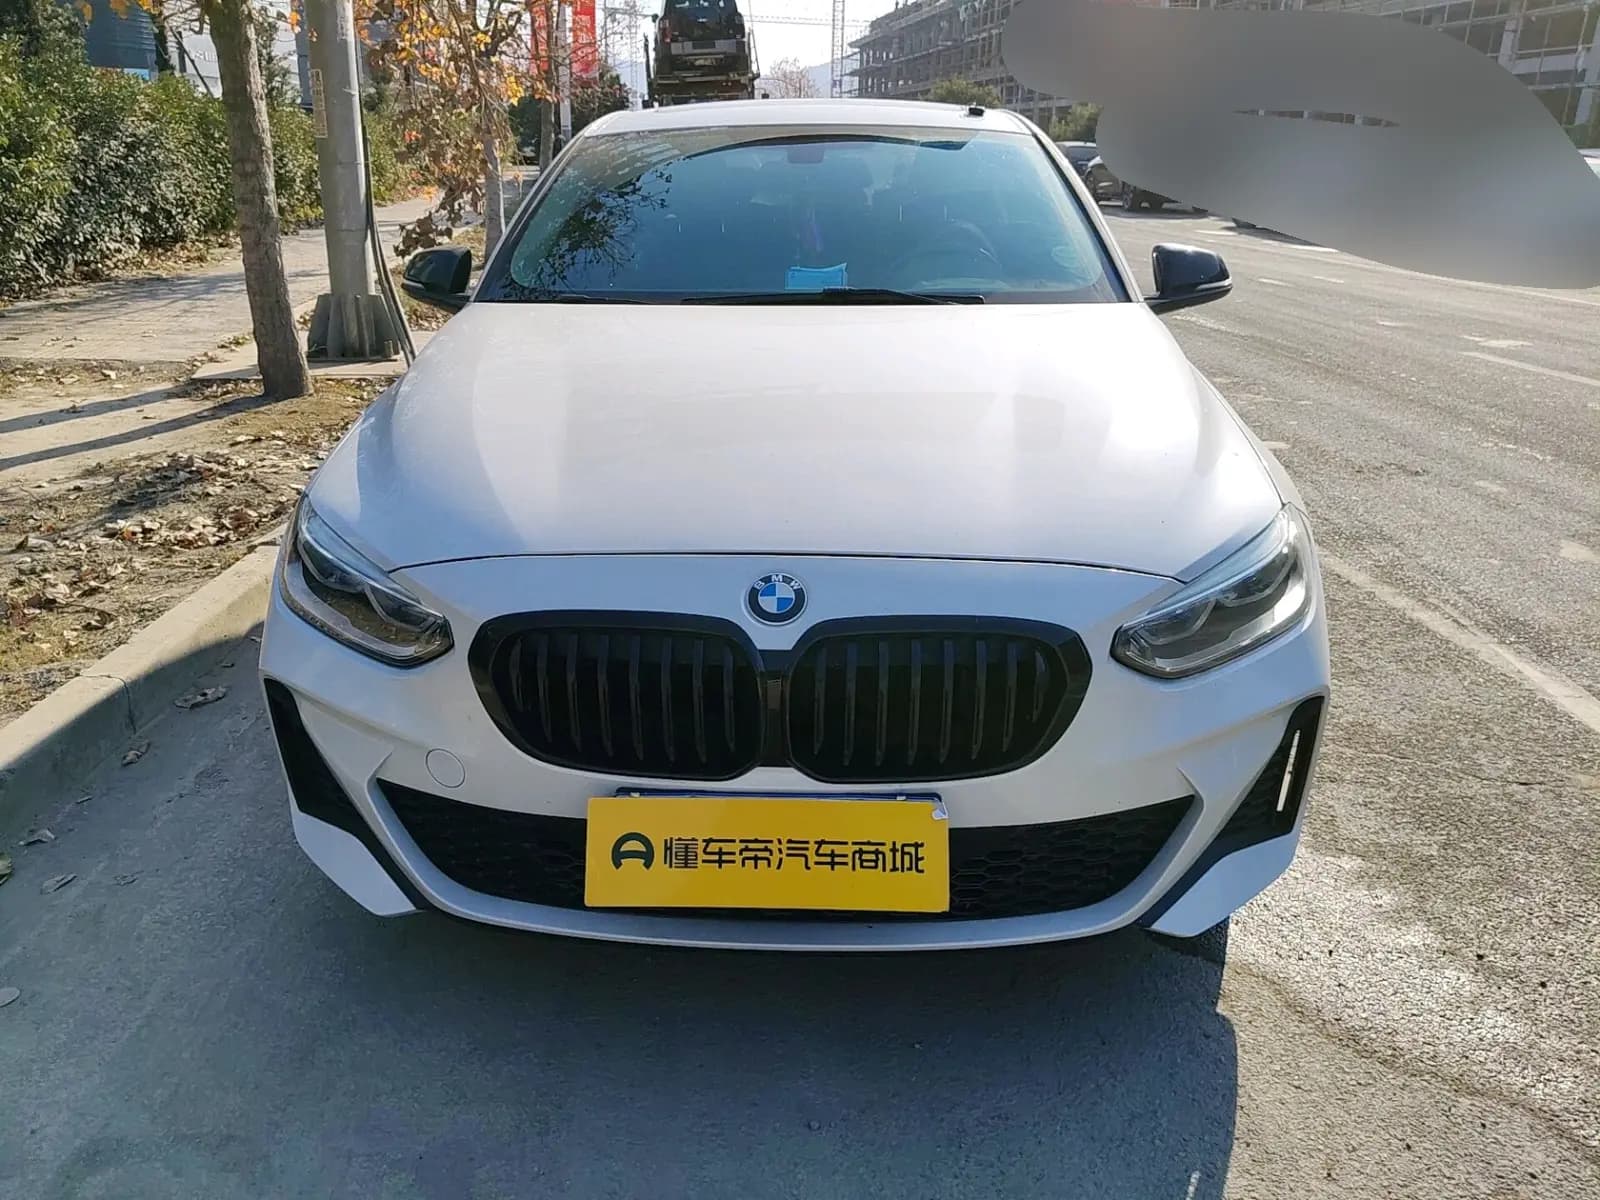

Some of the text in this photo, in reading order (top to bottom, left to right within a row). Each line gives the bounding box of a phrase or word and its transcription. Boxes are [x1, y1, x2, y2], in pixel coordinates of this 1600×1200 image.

[753, 574, 801, 590] BMW
[663, 836, 925, 873] 懂车帝汽车商城
